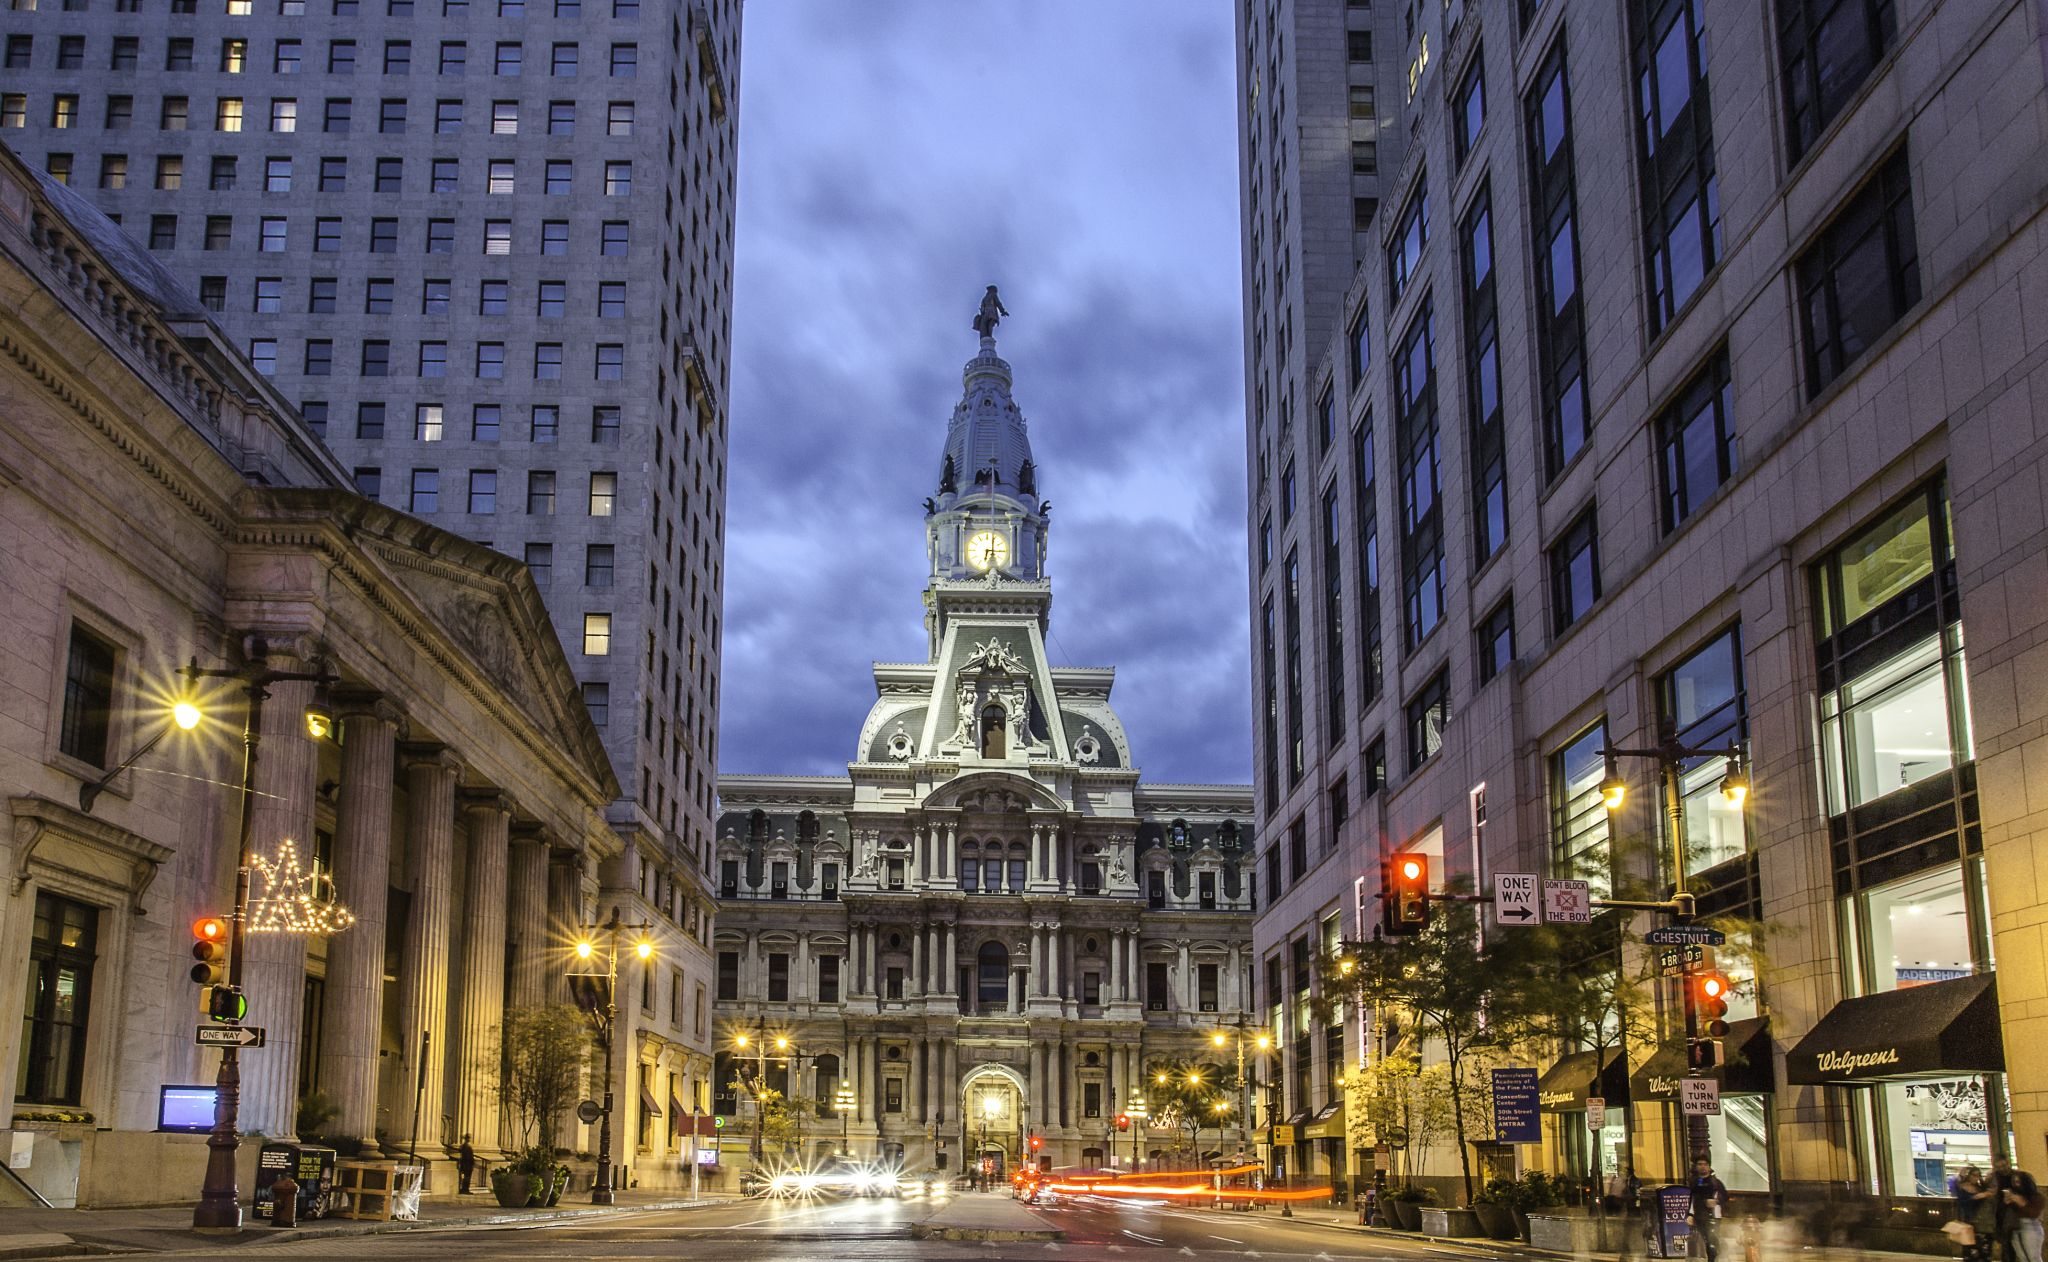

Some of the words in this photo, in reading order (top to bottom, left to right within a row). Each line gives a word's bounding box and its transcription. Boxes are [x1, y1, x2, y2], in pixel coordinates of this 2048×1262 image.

[1503, 877, 1530, 889] ONE
[1502, 891, 1531, 902] WAY
[1548, 912, 1566, 920] THE
[1569, 913, 1587, 921] BOX
[1652, 932, 1710, 944] CHESTNUT
[1667, 950, 1693, 966] BROAD
[1695, 952, 1702, 960] ST
[202, 1031, 220, 1039] ONE
[222, 1031, 240, 1040] WAY
[1816, 1048, 1899, 1075] Walgreens
[1693, 1082, 1706, 1090] NO
[1539, 1091, 1575, 1108] Walgreens
